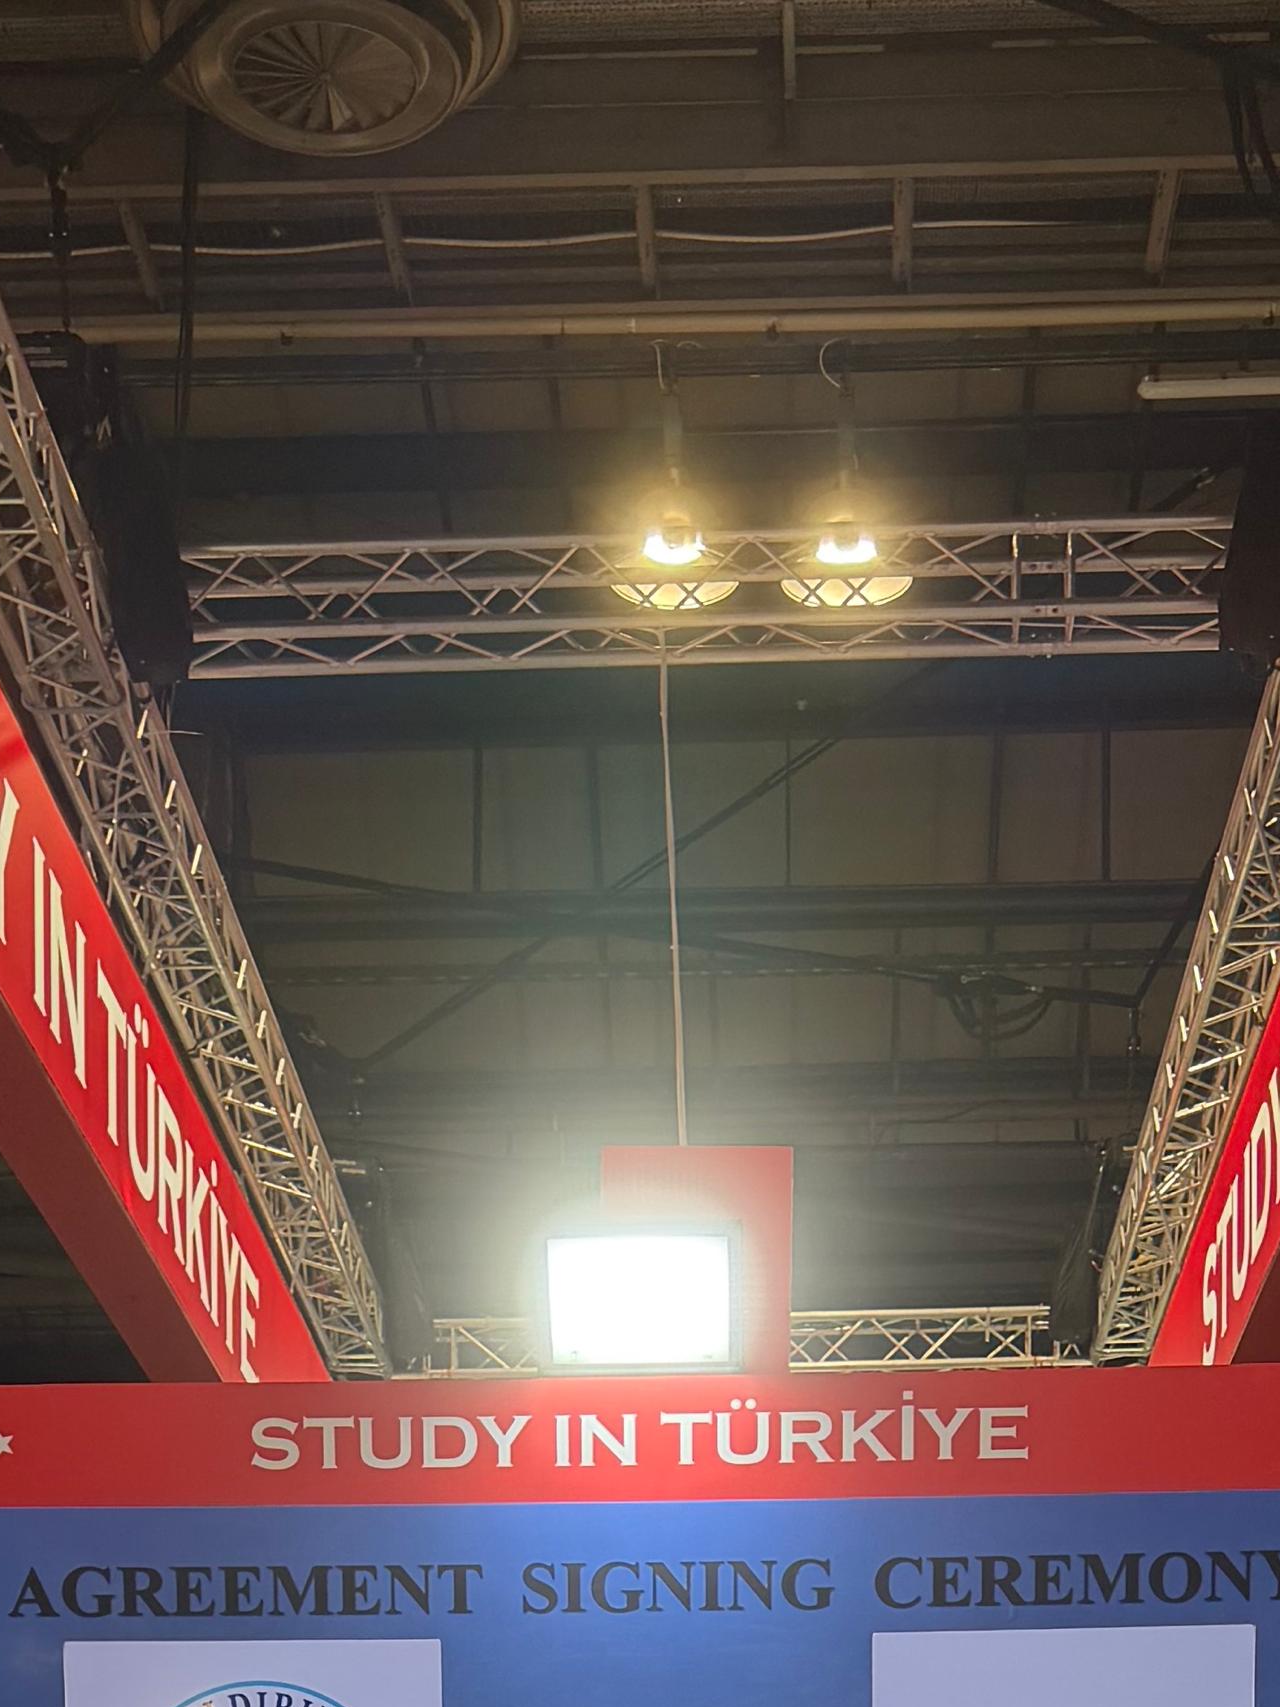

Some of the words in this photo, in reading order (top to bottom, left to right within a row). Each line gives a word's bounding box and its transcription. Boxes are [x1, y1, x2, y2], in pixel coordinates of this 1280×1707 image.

[30, 836, 91, 1090] IN
[96, 974, 261, 1385] TÜRKİYE
[251, 1414, 532, 1470] STUDY
[553, 1413, 639, 1468] IN
[660, 1390, 1029, 1465] TÜRKİYE
[8, 1562, 484, 1618] AGREEMENT
[521, 1558, 835, 1616] SIGNING
